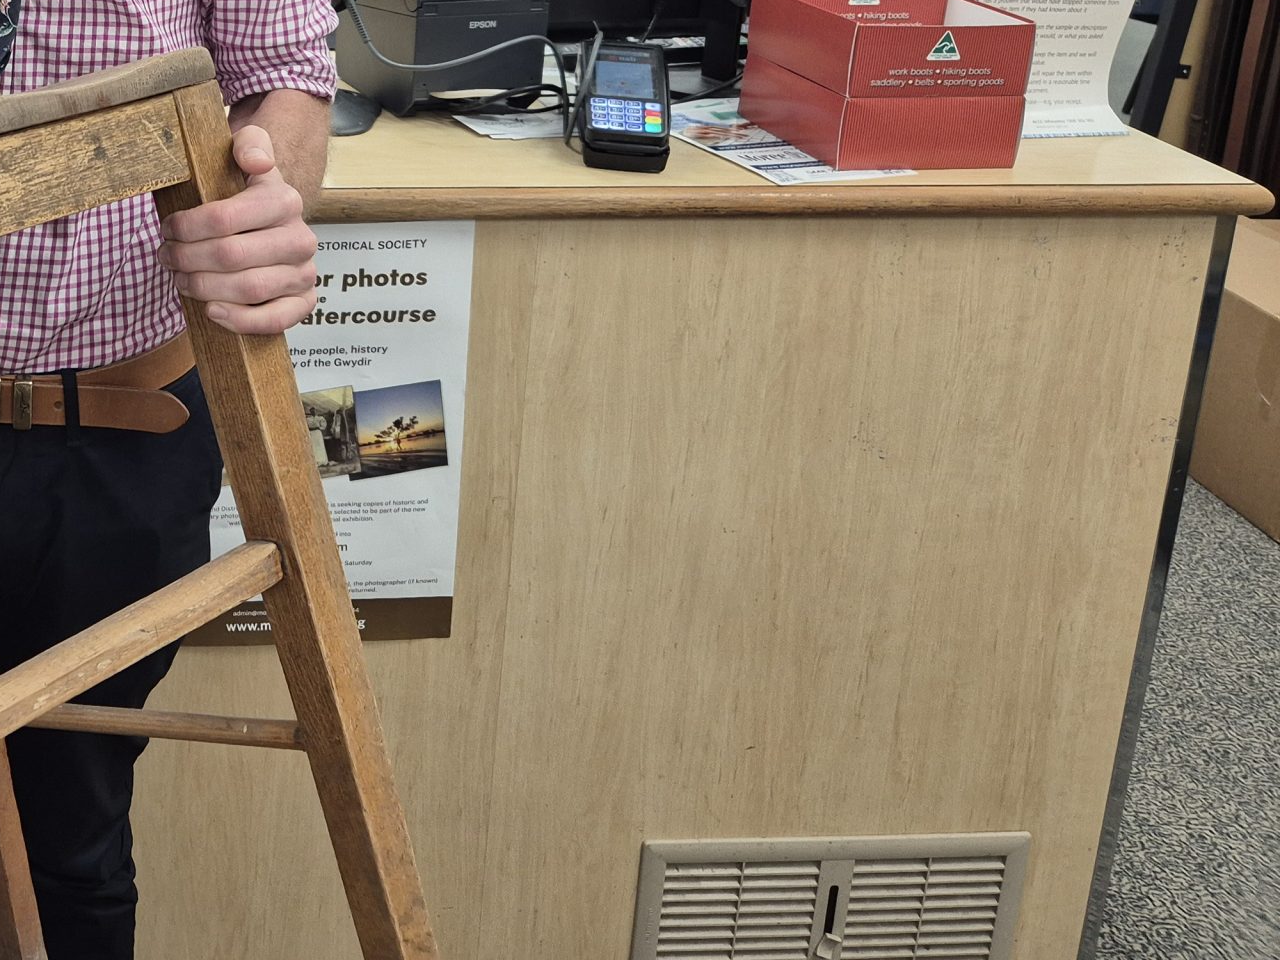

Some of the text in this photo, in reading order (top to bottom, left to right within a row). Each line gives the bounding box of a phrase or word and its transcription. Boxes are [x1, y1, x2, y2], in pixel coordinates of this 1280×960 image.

[888, 12, 909, 20] boots
[469, 20, 497, 29] EPSON
[889, 68, 908, 76] work
[910, 68, 933, 76] boots
[942, 68, 966, 77] hiking
[870, 78, 1004, 88] saddlery belts sporting goods
[318, 239, 427, 251] STORICAL SOCIETY
[341, 268, 428, 292] photos
[301, 308, 436, 326] atercourse
[289, 345, 388, 356] the people, history
[300, 357, 373, 368] of the Gwydir
[337, 501, 362, 509] seeking
[364, 579, 407, 587] photographer
[415, 577, 438, 585] known)
[226, 621, 272, 632] www.m
